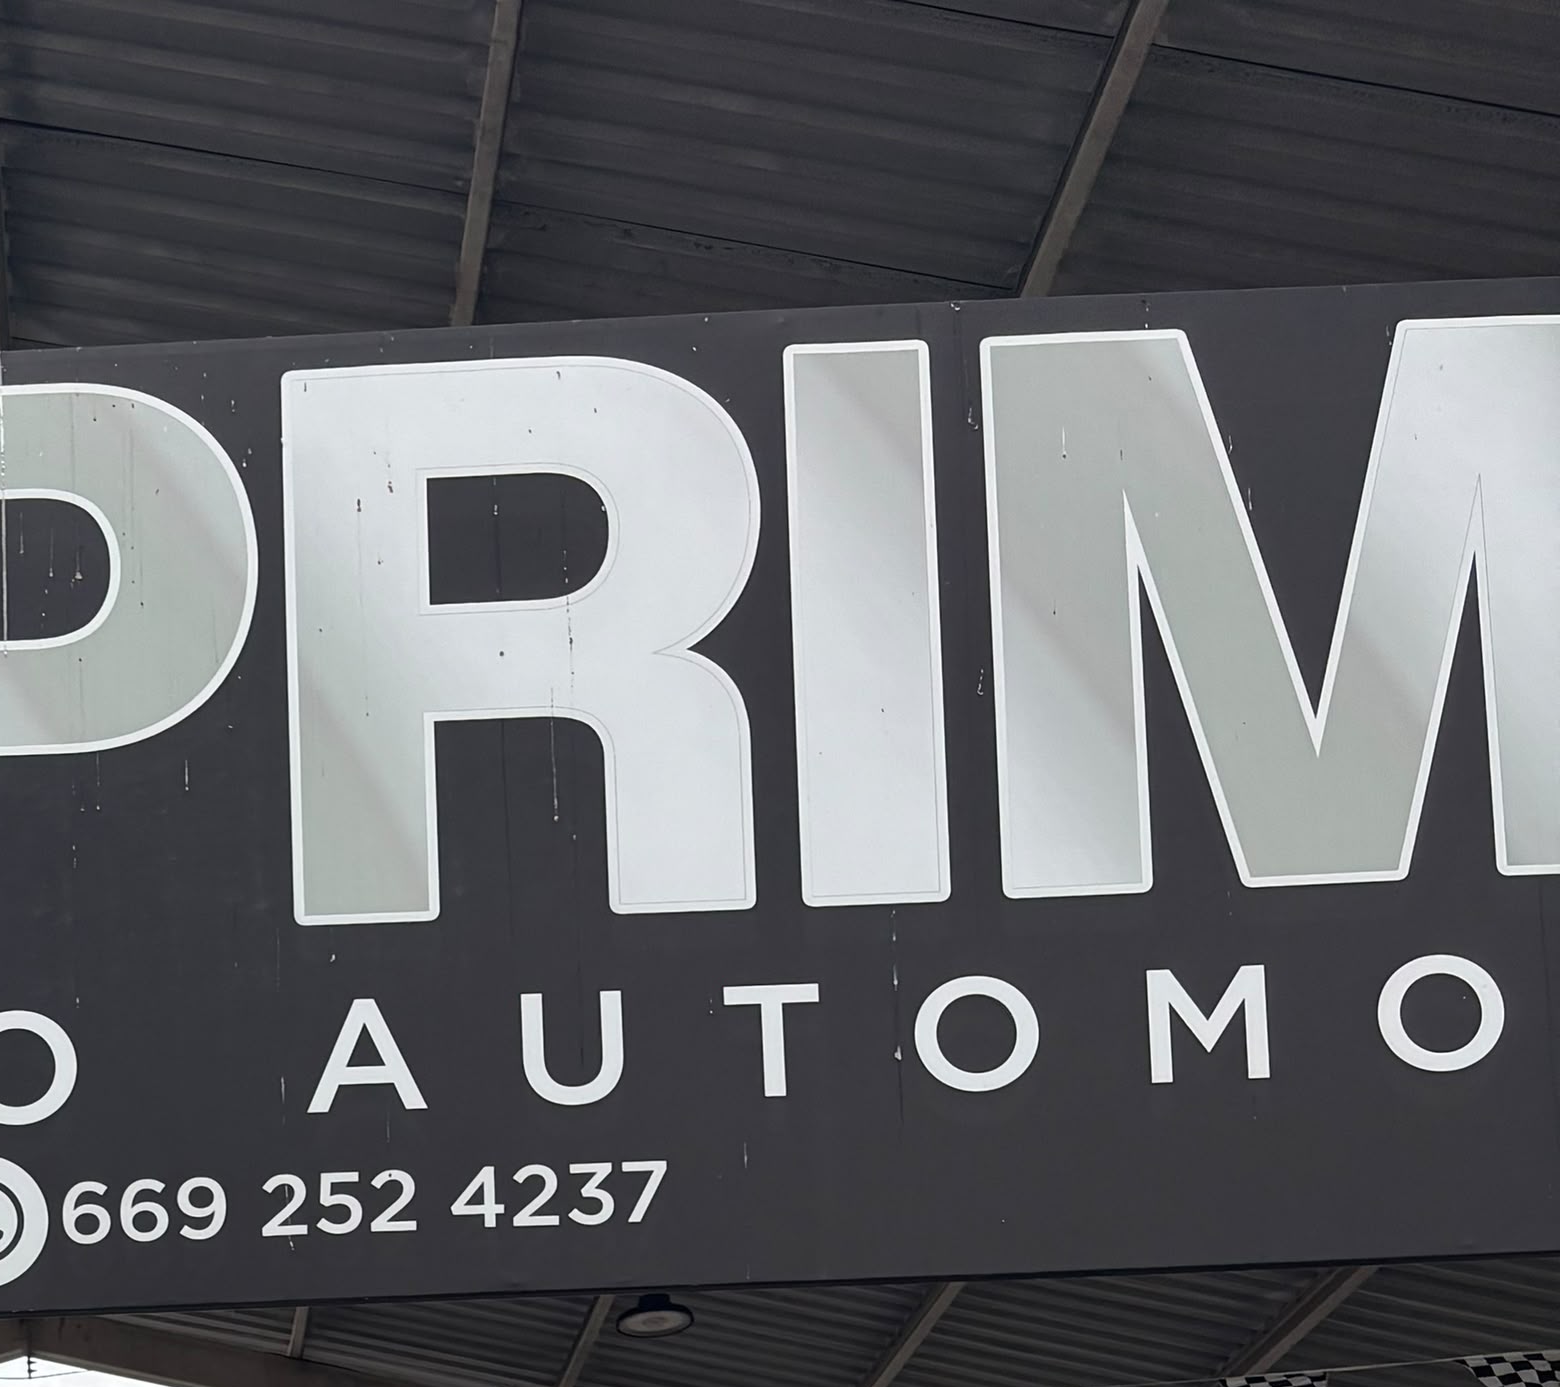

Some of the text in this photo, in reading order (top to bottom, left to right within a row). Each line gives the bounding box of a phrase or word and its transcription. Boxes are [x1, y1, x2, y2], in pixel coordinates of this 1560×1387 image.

[308, 955, 1504, 1113] AUTOMO
[63, 1177, 226, 1244] 669
[262, 1170, 416, 1236] 252
[451, 1161, 666, 1227] 4237
